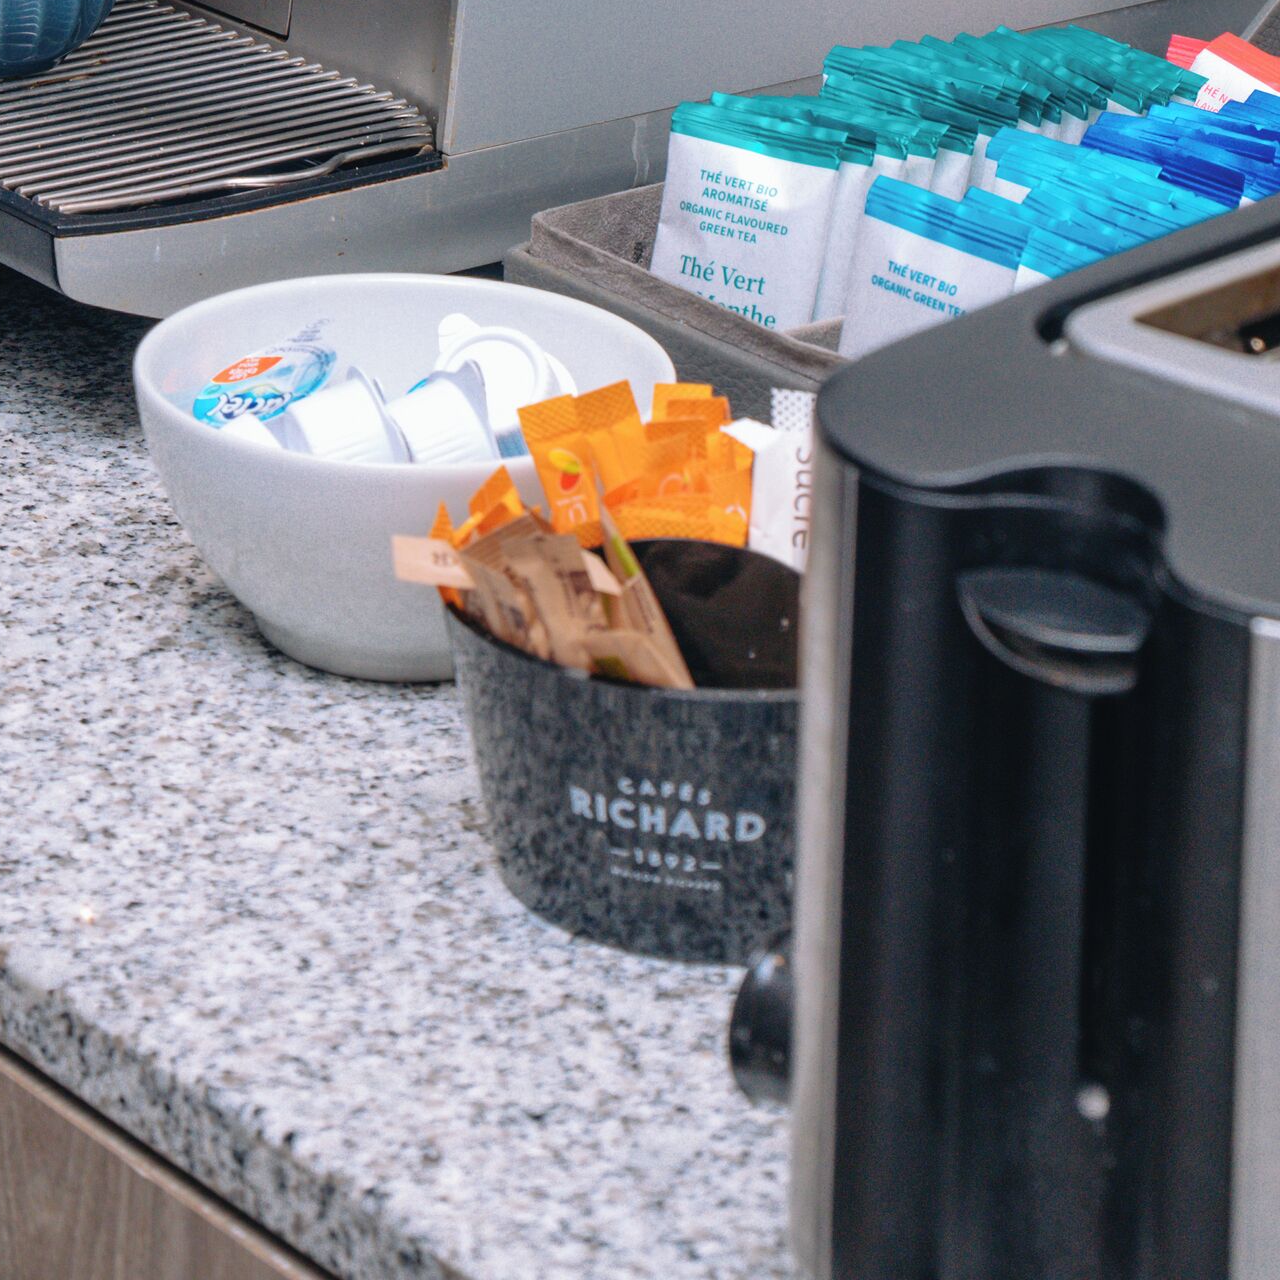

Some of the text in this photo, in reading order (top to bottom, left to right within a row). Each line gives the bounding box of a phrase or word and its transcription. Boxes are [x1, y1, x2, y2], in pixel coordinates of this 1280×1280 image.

[700, 169, 778, 198] THÉ VERT BIO
[701, 187, 769, 213] AROMATISÉ
[679, 200, 789, 236] ORGANIC FLAVOURED
[699, 220, 757, 244] GREEN TEA
[680, 254, 766, 295] Thé Vert
[888, 260, 958, 297] THÉ VERT BIO
[871, 274, 912, 300] ORGANIC
[913, 291, 946, 313] GREEN
[570, 785, 766, 842] RICHARD
